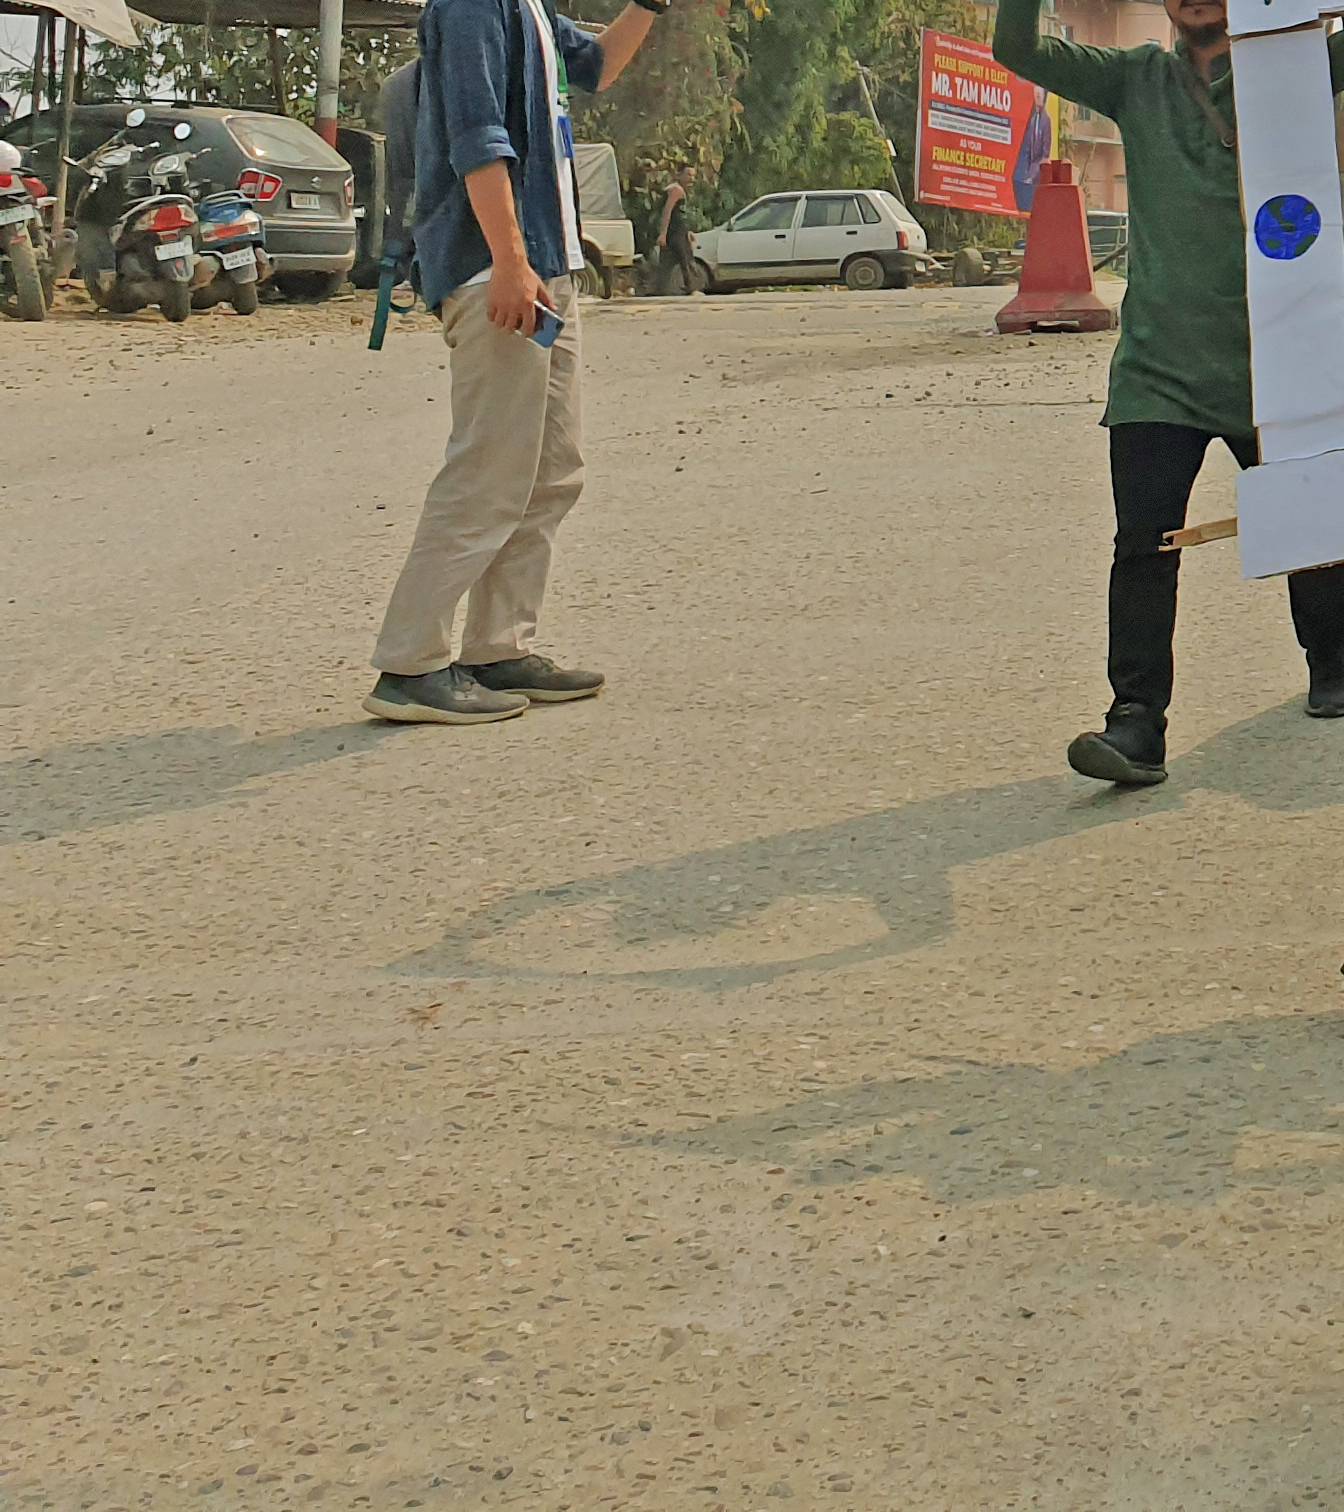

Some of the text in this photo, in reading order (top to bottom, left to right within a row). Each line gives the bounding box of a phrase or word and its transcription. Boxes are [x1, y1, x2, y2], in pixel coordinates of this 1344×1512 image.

[932, 70, 953, 98] MR.
[955, 76, 978, 104] TAM
[981, 83, 1012, 113] MALO
[932, 146, 965, 165] FINANCE
[965, 152, 1006, 173] SECRETARY
